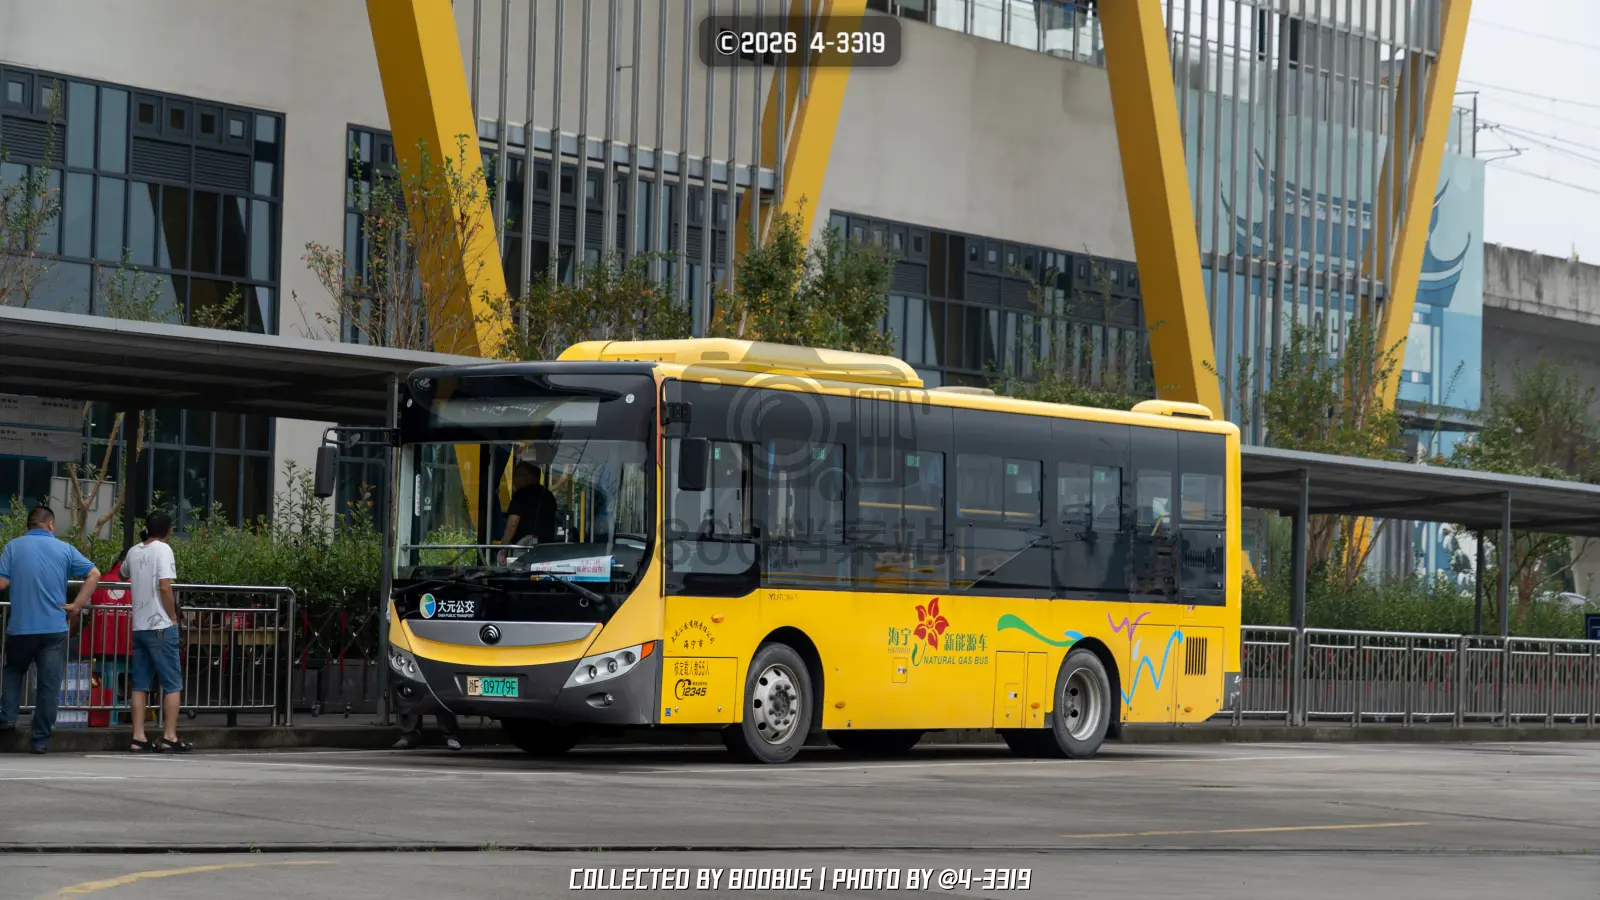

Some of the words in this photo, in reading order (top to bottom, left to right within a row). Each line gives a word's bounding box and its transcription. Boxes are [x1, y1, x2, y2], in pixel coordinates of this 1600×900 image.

[437, 600, 475, 613] 大元公交
[888, 626, 912, 646] 海宁
[944, 633, 989, 652] 新能源车
[924, 656, 956, 665] NATURAL
[958, 656, 973, 665] GAS
[974, 656, 989, 665] BUS
[682, 687, 707, 696] 12345
